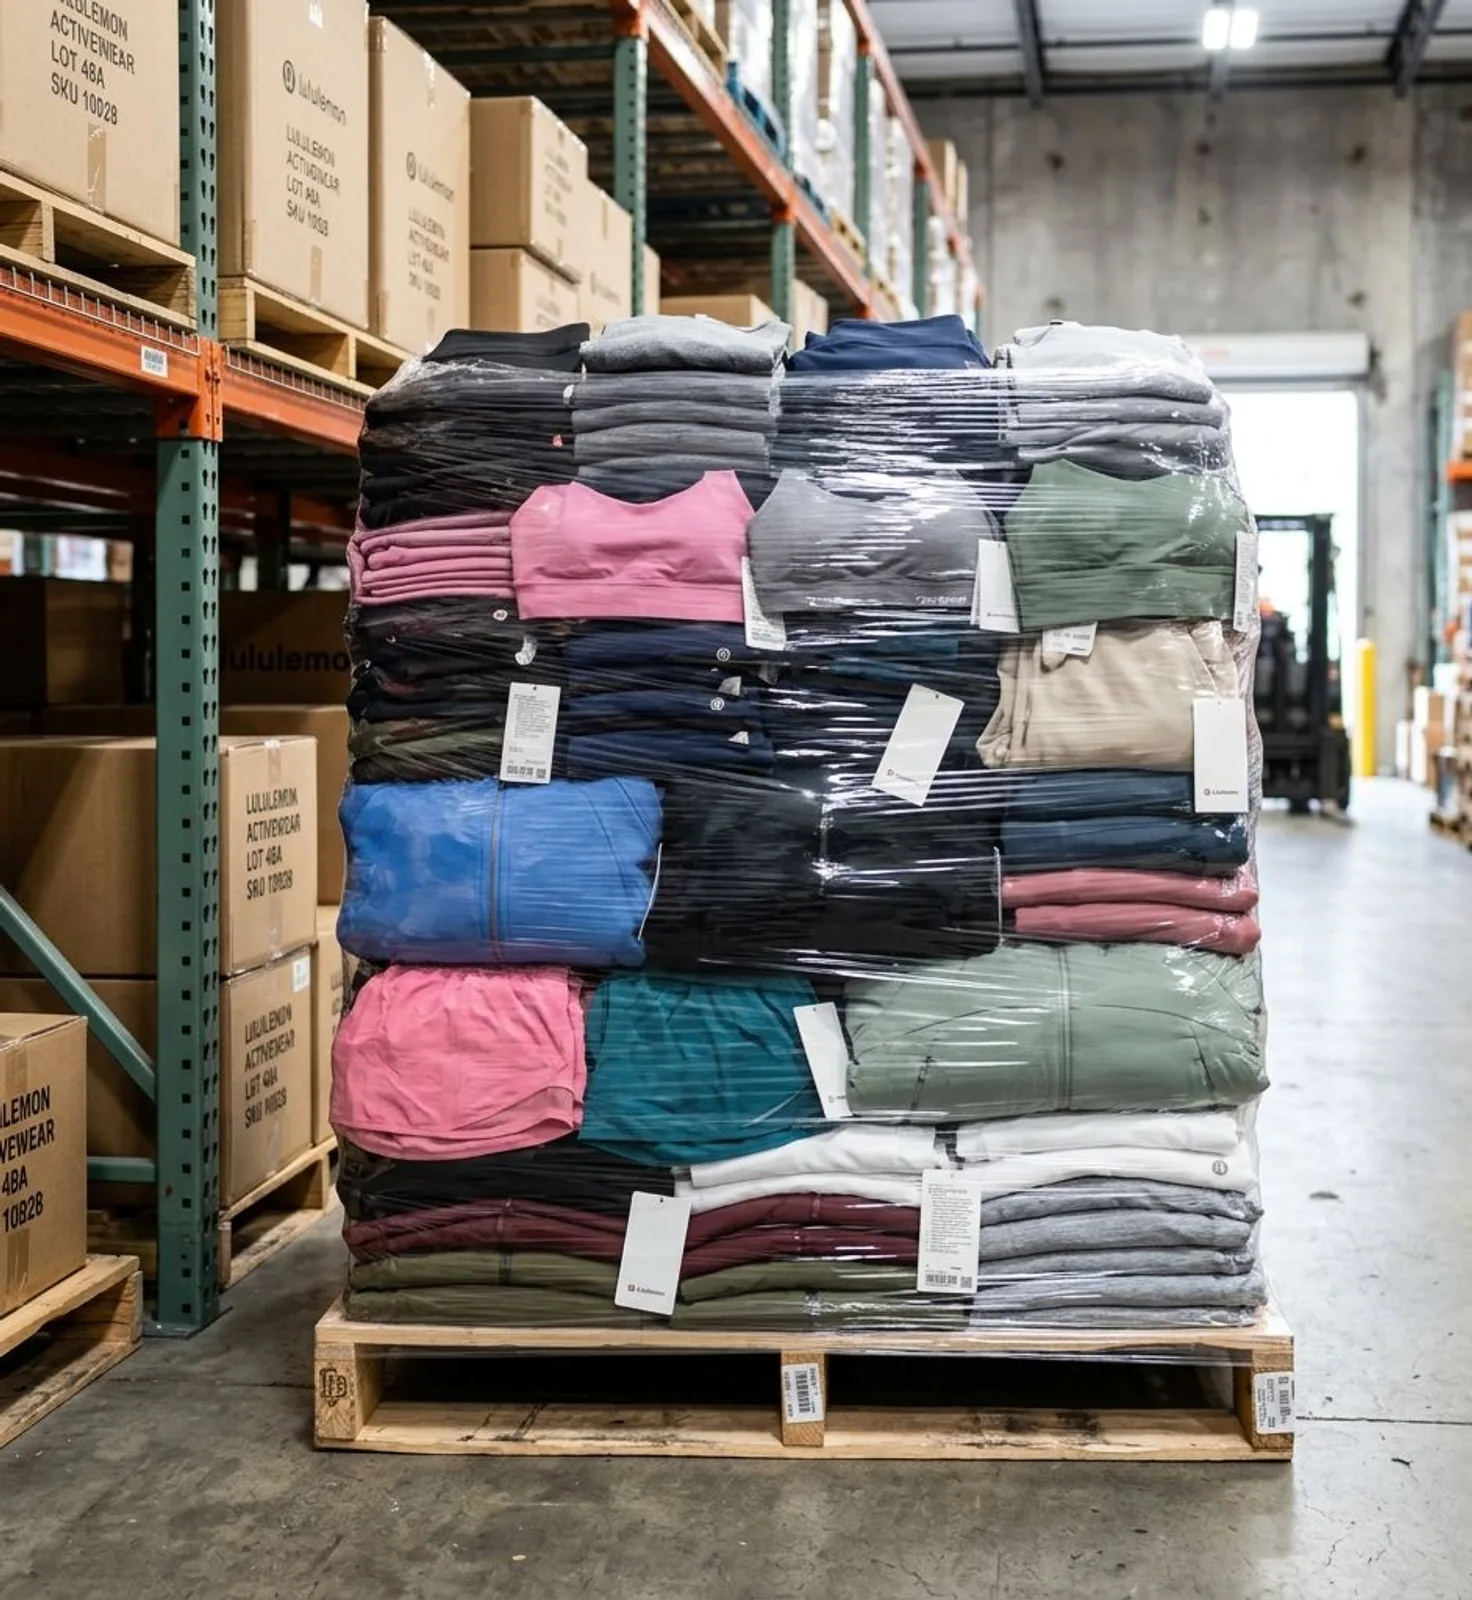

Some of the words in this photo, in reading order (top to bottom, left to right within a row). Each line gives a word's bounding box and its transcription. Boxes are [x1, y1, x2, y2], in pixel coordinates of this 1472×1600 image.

[51, 40, 78, 72] LOT
[81, 58, 106, 89] 48A
[51, 72, 78, 104] SKU
[246, 848, 264, 872] LOT
[0, 1085, 51, 1129] LEMON
